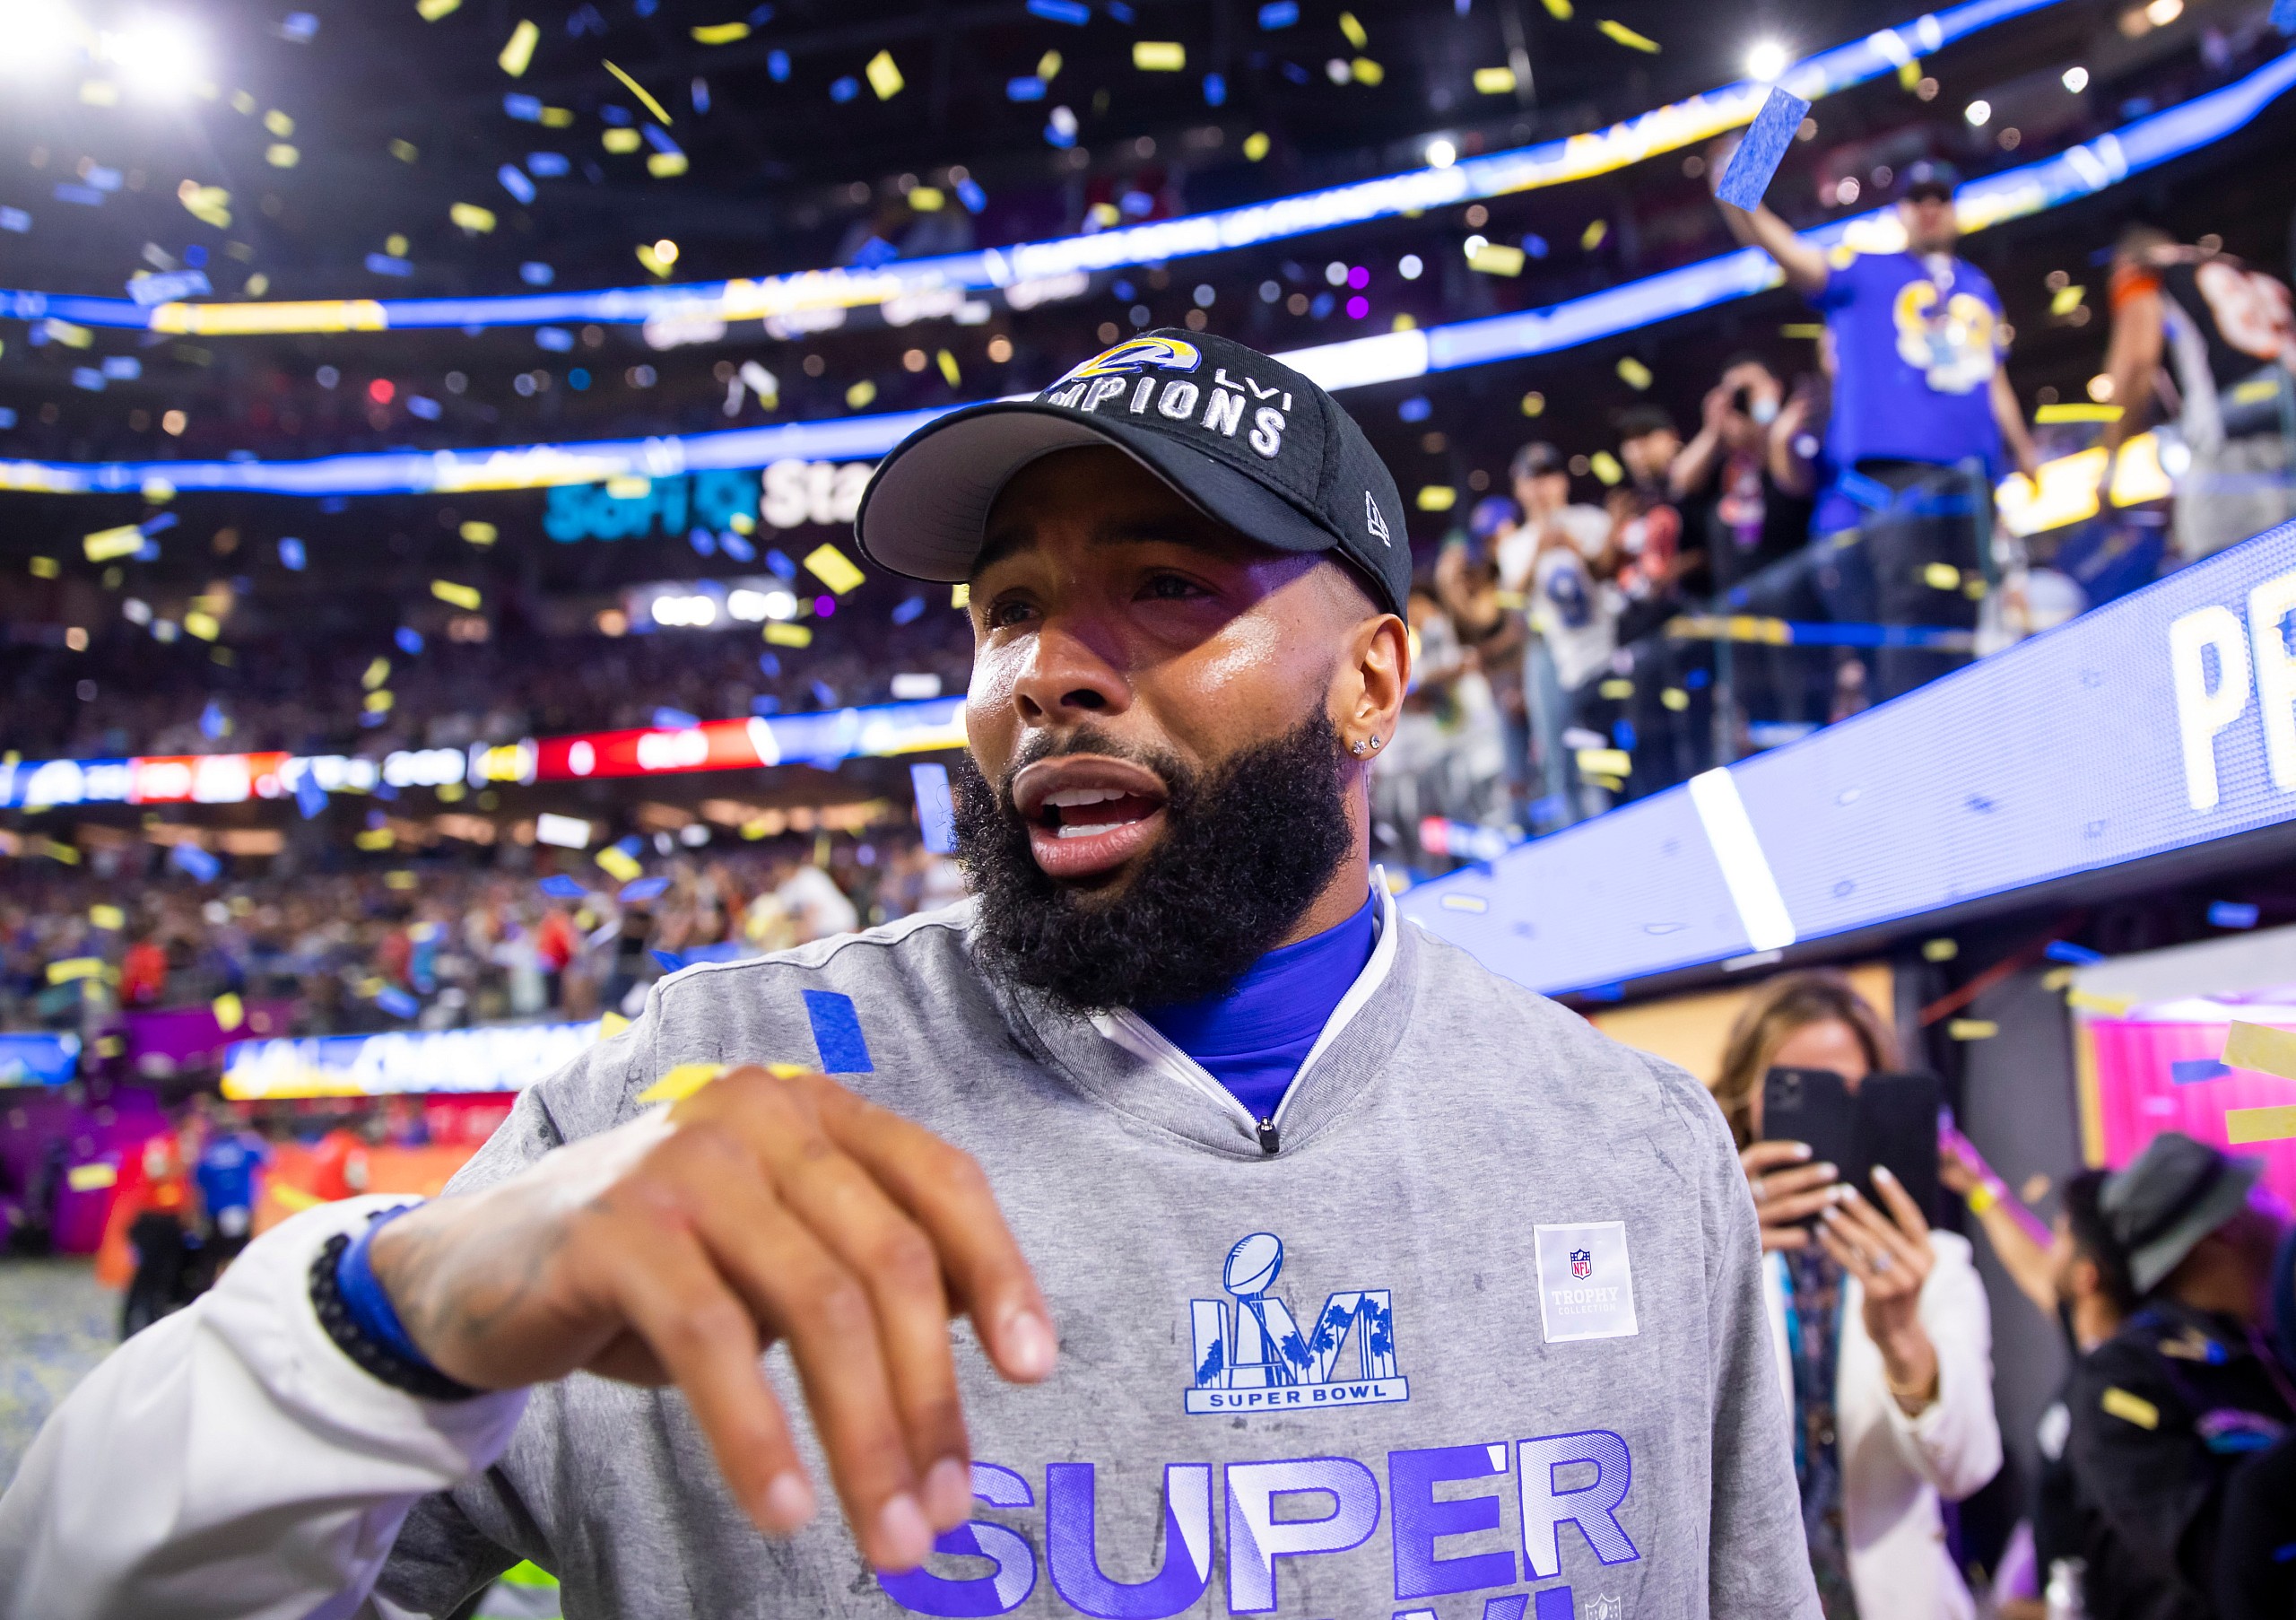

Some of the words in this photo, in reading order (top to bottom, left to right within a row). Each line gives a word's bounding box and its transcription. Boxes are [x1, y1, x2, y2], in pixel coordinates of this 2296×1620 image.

[1214, 369, 1292, 412] LVI
[1573, 1261, 1590, 1276] NFL
[1551, 1286, 1619, 1305] TROPHY
[1559, 1302, 1616, 1315] COLLECTION
[1210, 1390, 1300, 1407] SUPER
[1313, 1384, 1387, 1402] BOWL
[876, 1429, 1641, 1620] SUPER
